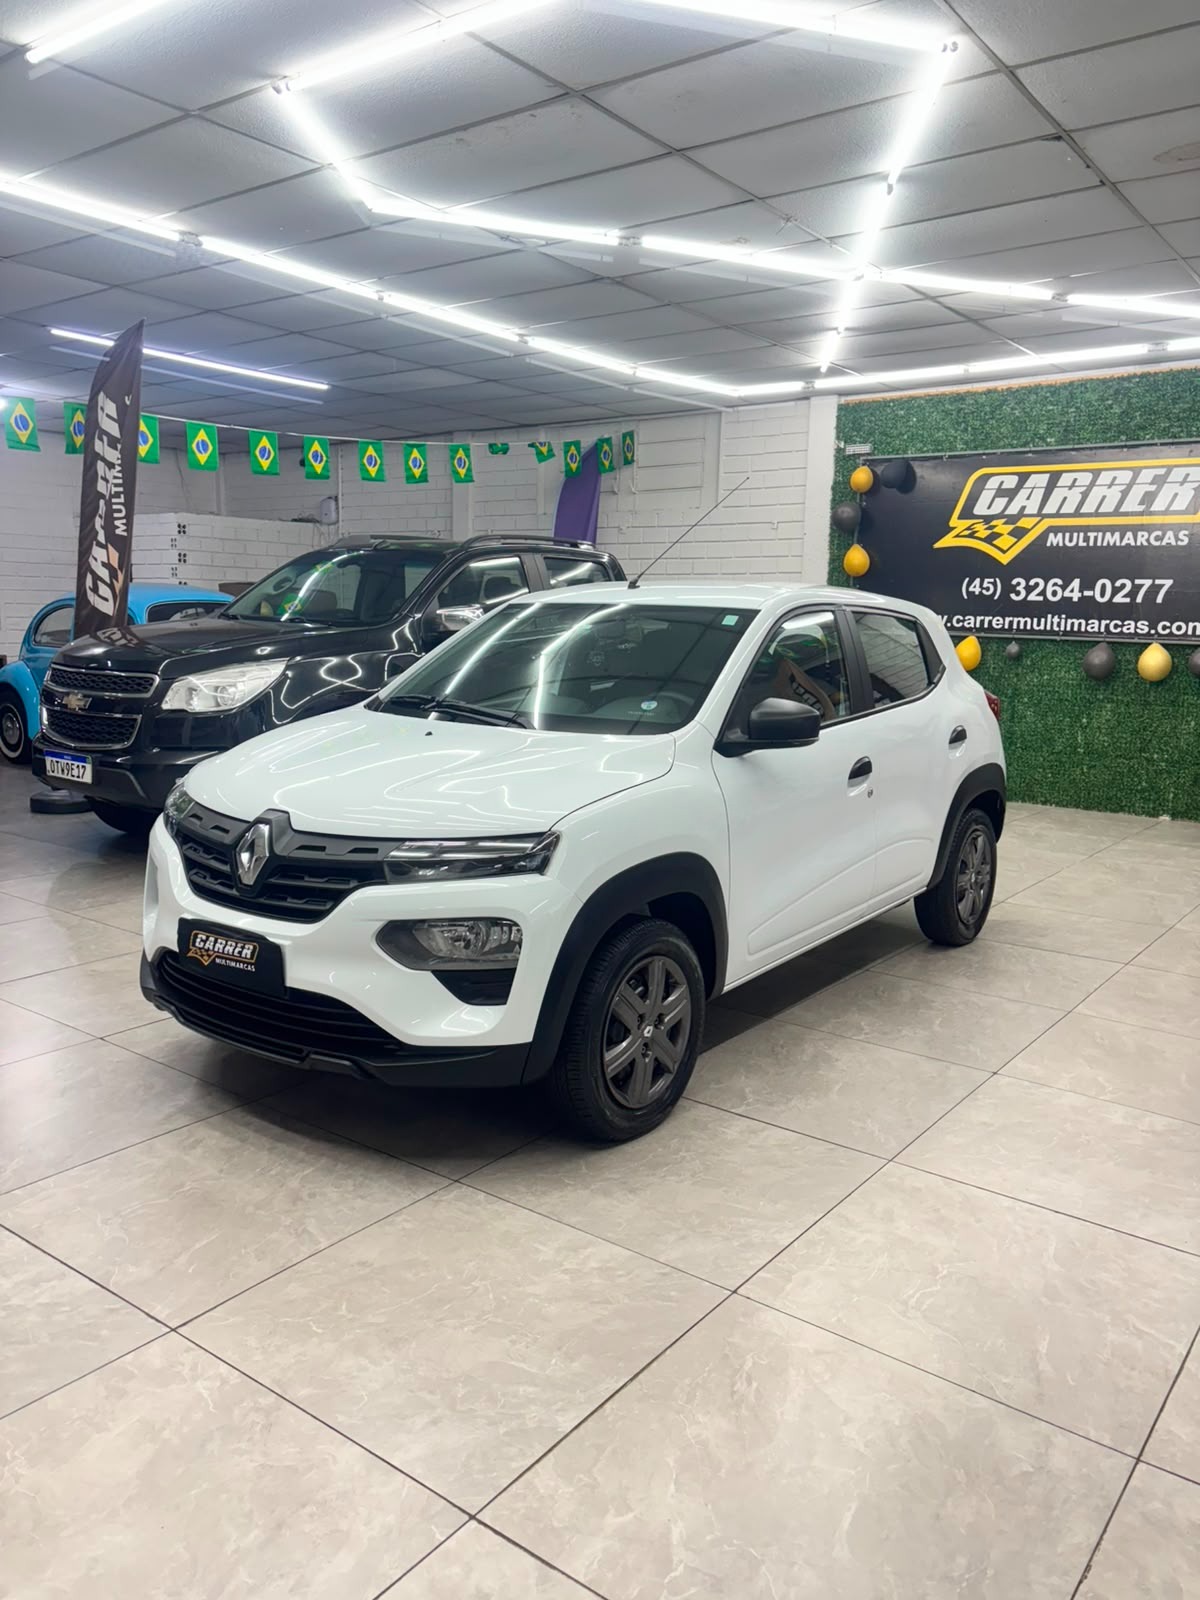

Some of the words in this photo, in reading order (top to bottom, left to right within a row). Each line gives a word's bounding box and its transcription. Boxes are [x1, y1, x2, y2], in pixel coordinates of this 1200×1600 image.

[973, 466, 1200, 515] CARRER
[1046, 530, 1190, 547] MULTIMARCAS
[961, 577, 1002, 600] (45)
[1009, 577, 1174, 604] 3264-0277
[195, 934, 254, 959] CARRER
[215, 957, 255, 972] MULTIMARCAS
